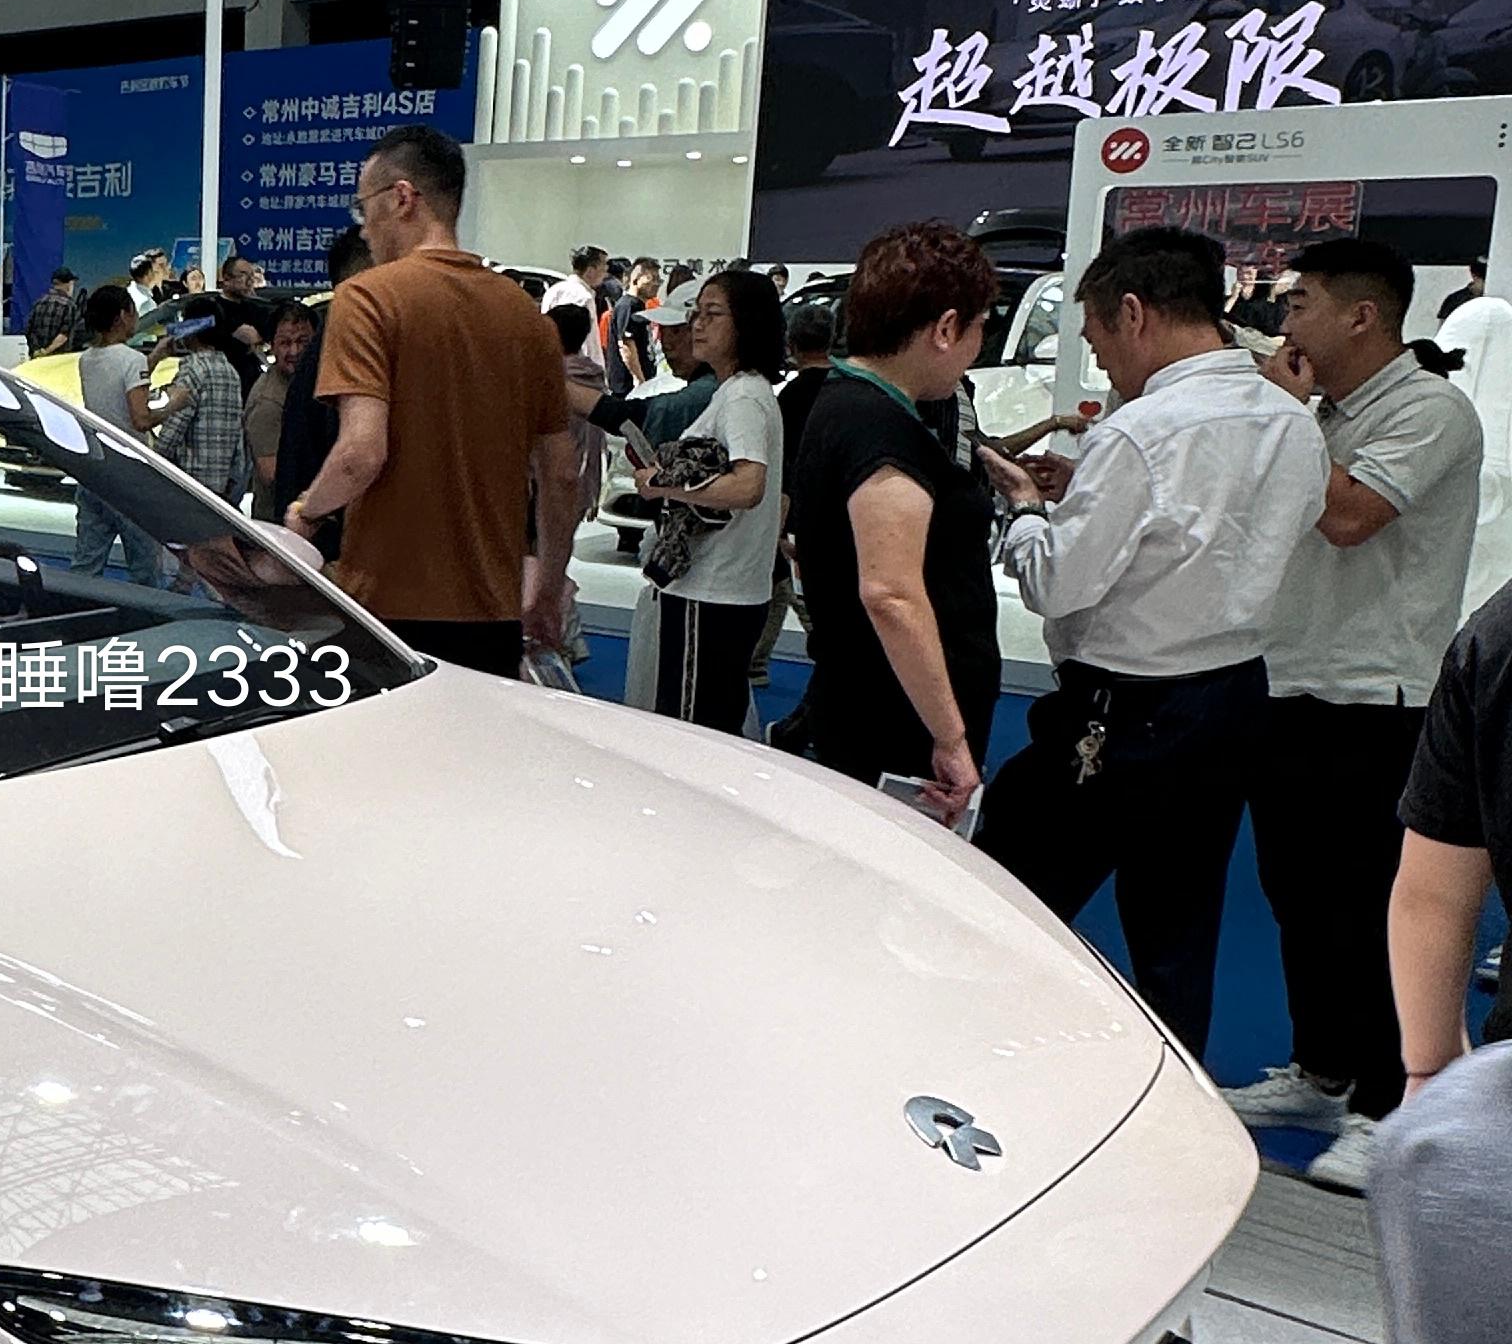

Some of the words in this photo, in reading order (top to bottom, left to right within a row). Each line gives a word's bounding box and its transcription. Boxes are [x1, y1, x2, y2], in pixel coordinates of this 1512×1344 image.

[888, 0, 1341, 148] 超越极限
[1120, 183, 1357, 233] 常州车展
[257, 226, 348, 252] 常州吉运
